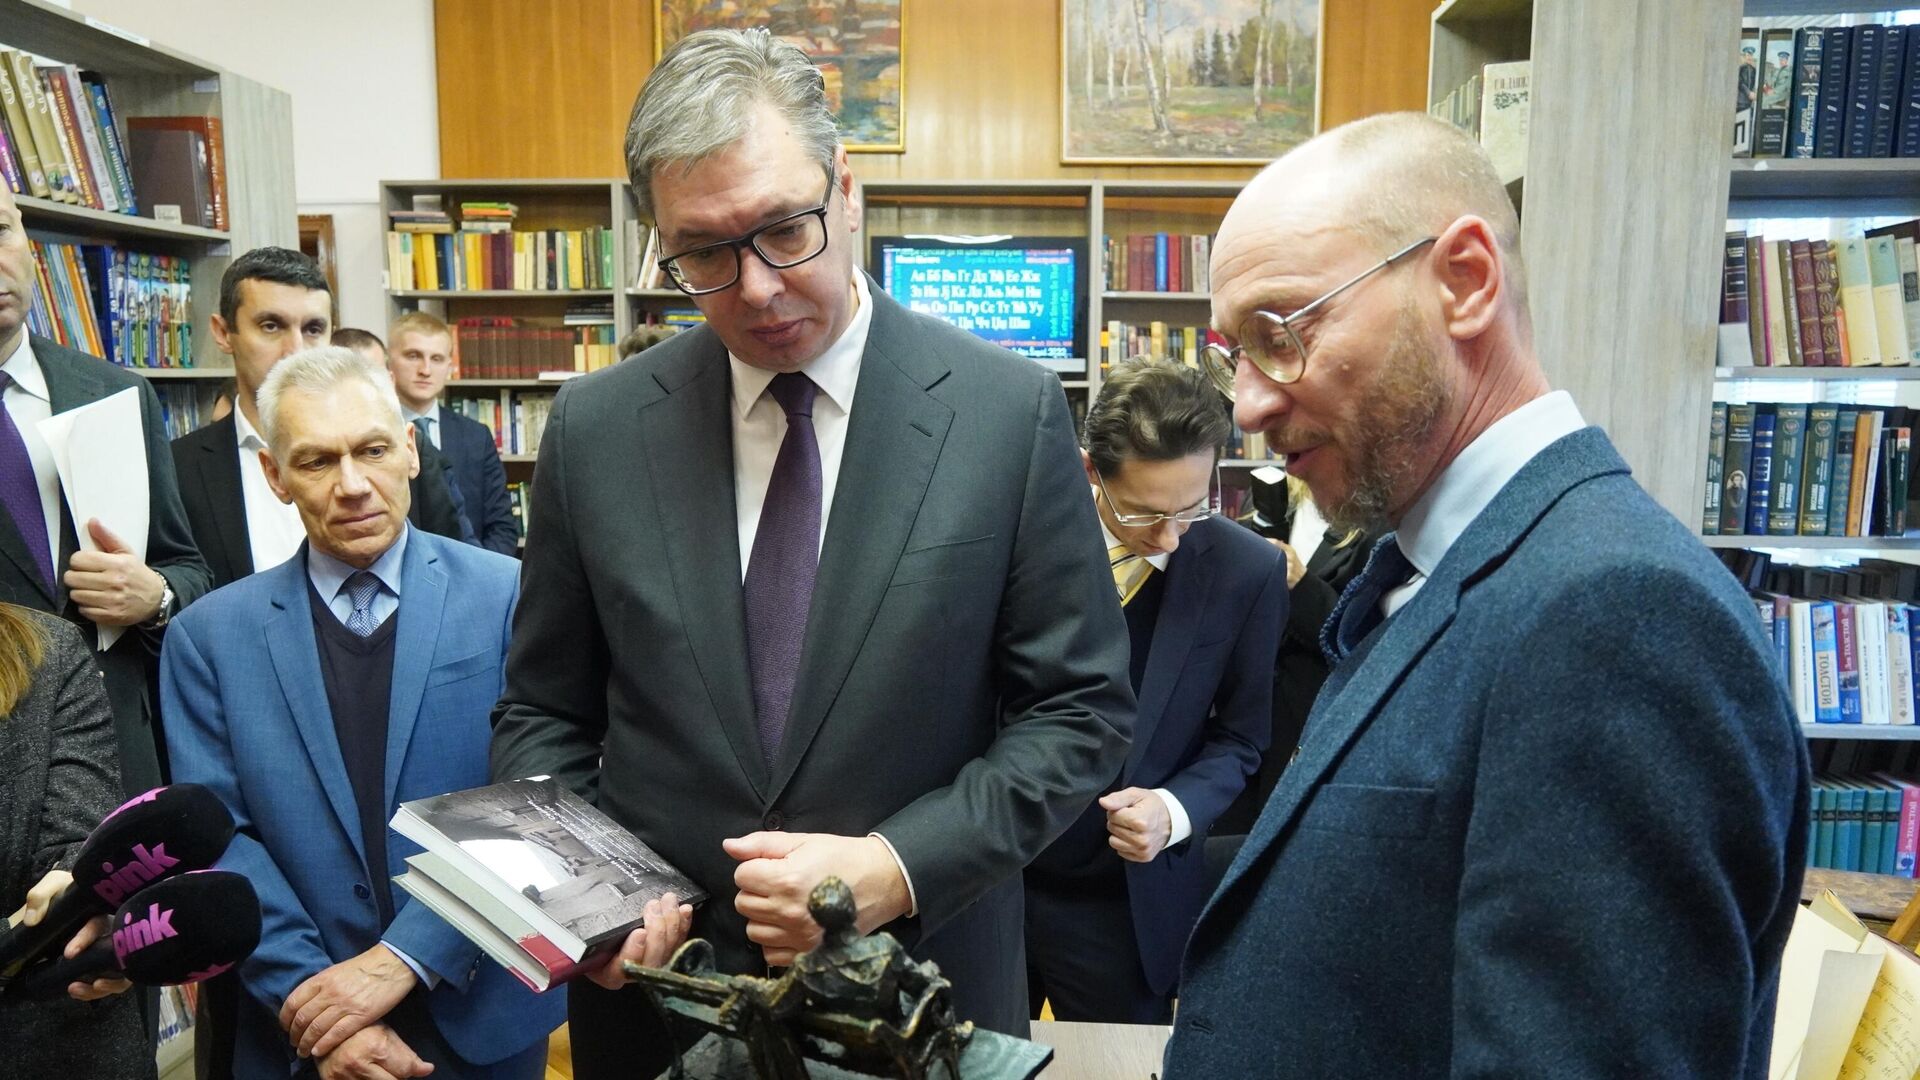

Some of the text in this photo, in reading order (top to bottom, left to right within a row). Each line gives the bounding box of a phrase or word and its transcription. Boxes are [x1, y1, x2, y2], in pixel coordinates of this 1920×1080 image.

[911, 269, 926, 282] Аа
[926, 269, 941, 282] Бб
[958, 269, 970, 282] Гг
[1005, 269, 1020, 282] Ее
[951, 285, 967, 298] Кк
[931, 300, 947, 313] Оо
[965, 300, 980, 316] Рр
[980, 300, 995, 313] Сс
[1028, 300, 1045, 317] Уу
[93, 843, 180, 907] pink
[112, 903, 179, 970] pink
